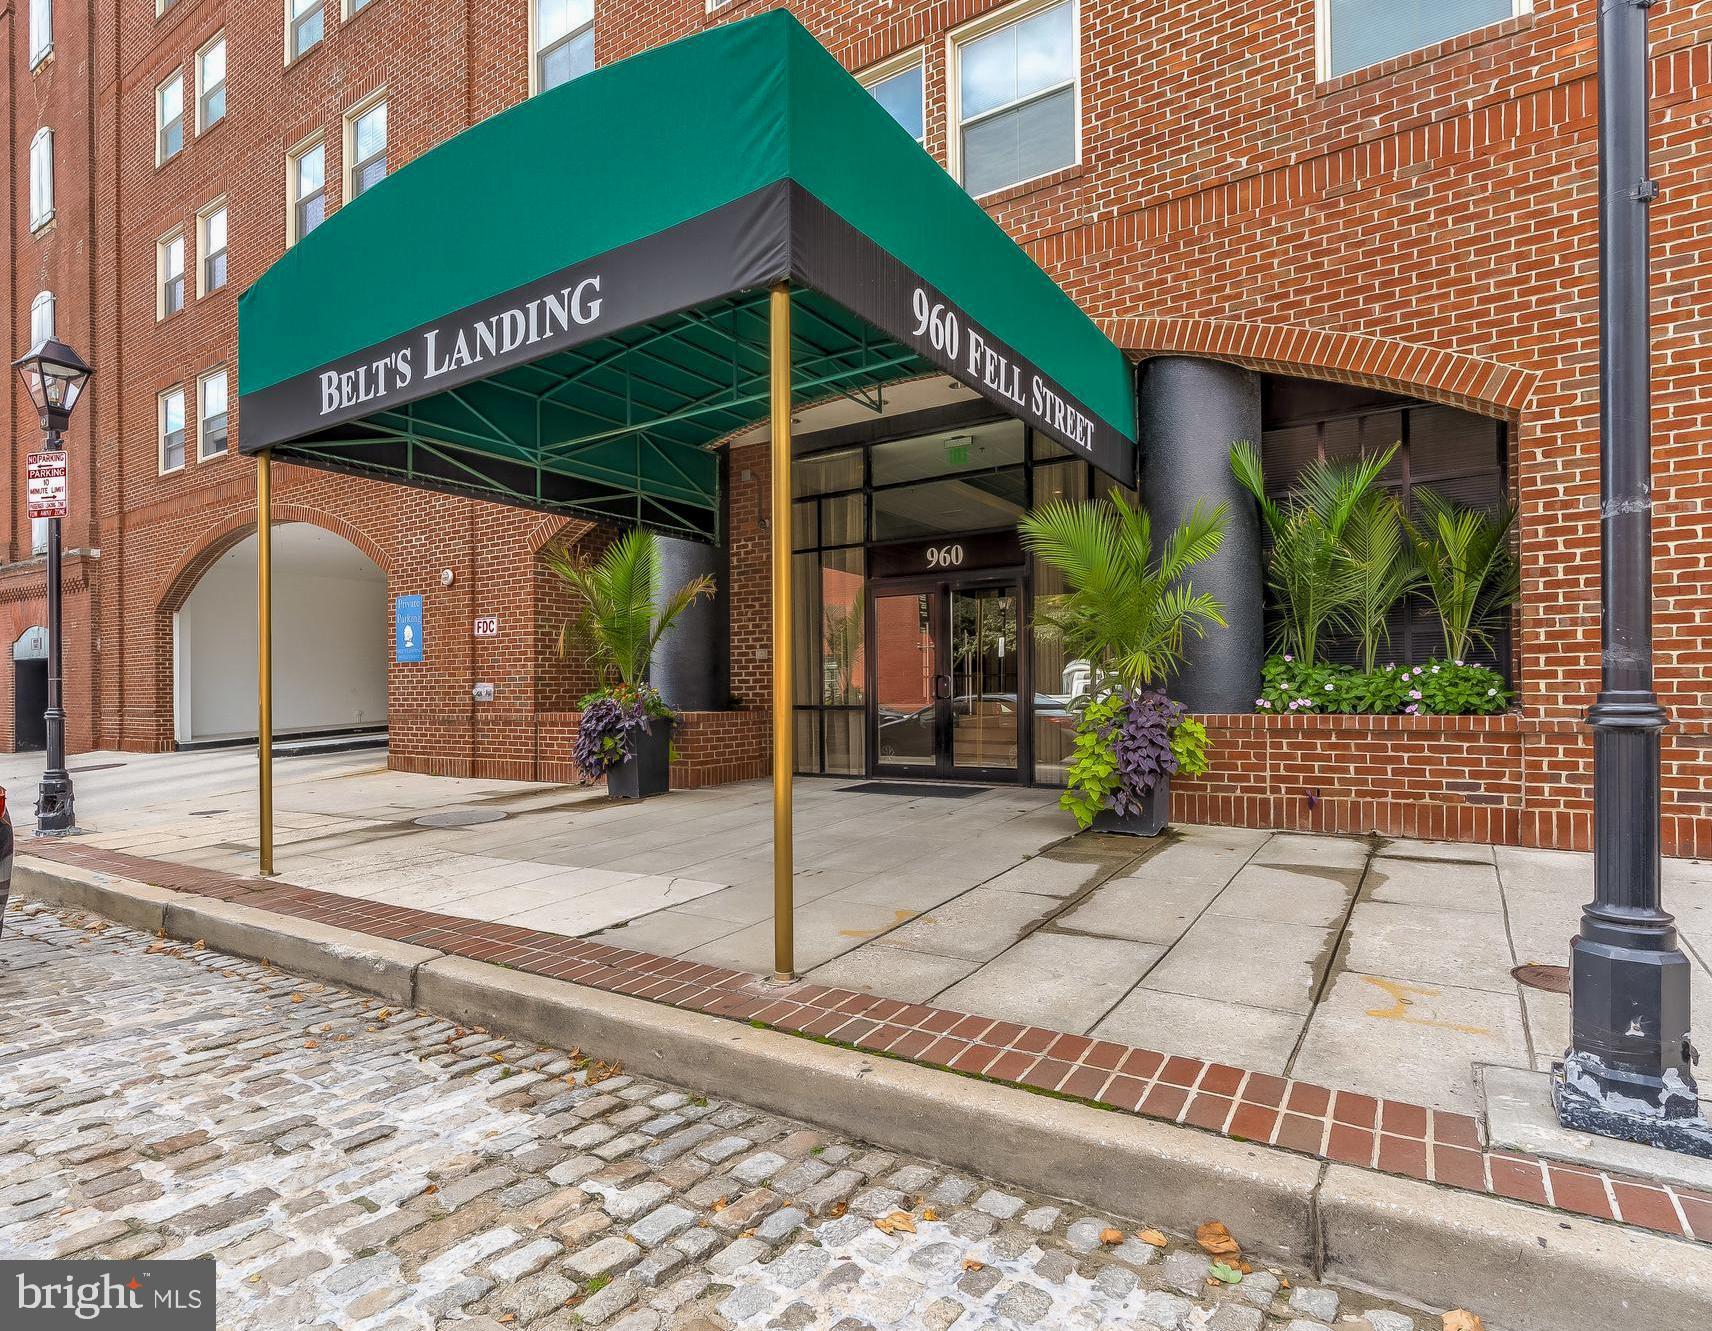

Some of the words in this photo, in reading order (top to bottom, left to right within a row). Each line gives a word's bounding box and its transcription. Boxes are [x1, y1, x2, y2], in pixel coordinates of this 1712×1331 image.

[319, 347, 412, 415] BELT'S
[424, 275, 603, 379] LANDING
[912, 288, 959, 360] 960
[967, 328, 1026, 406] FELL
[1032, 375, 1095, 451] STREET
[29, 455, 37, 464] NO
[38, 454, 65, 462] PARKING
[30, 468, 65, 478] PARKING
[926, 544, 964, 569] 960
[476, 620, 495, 633] FDC
